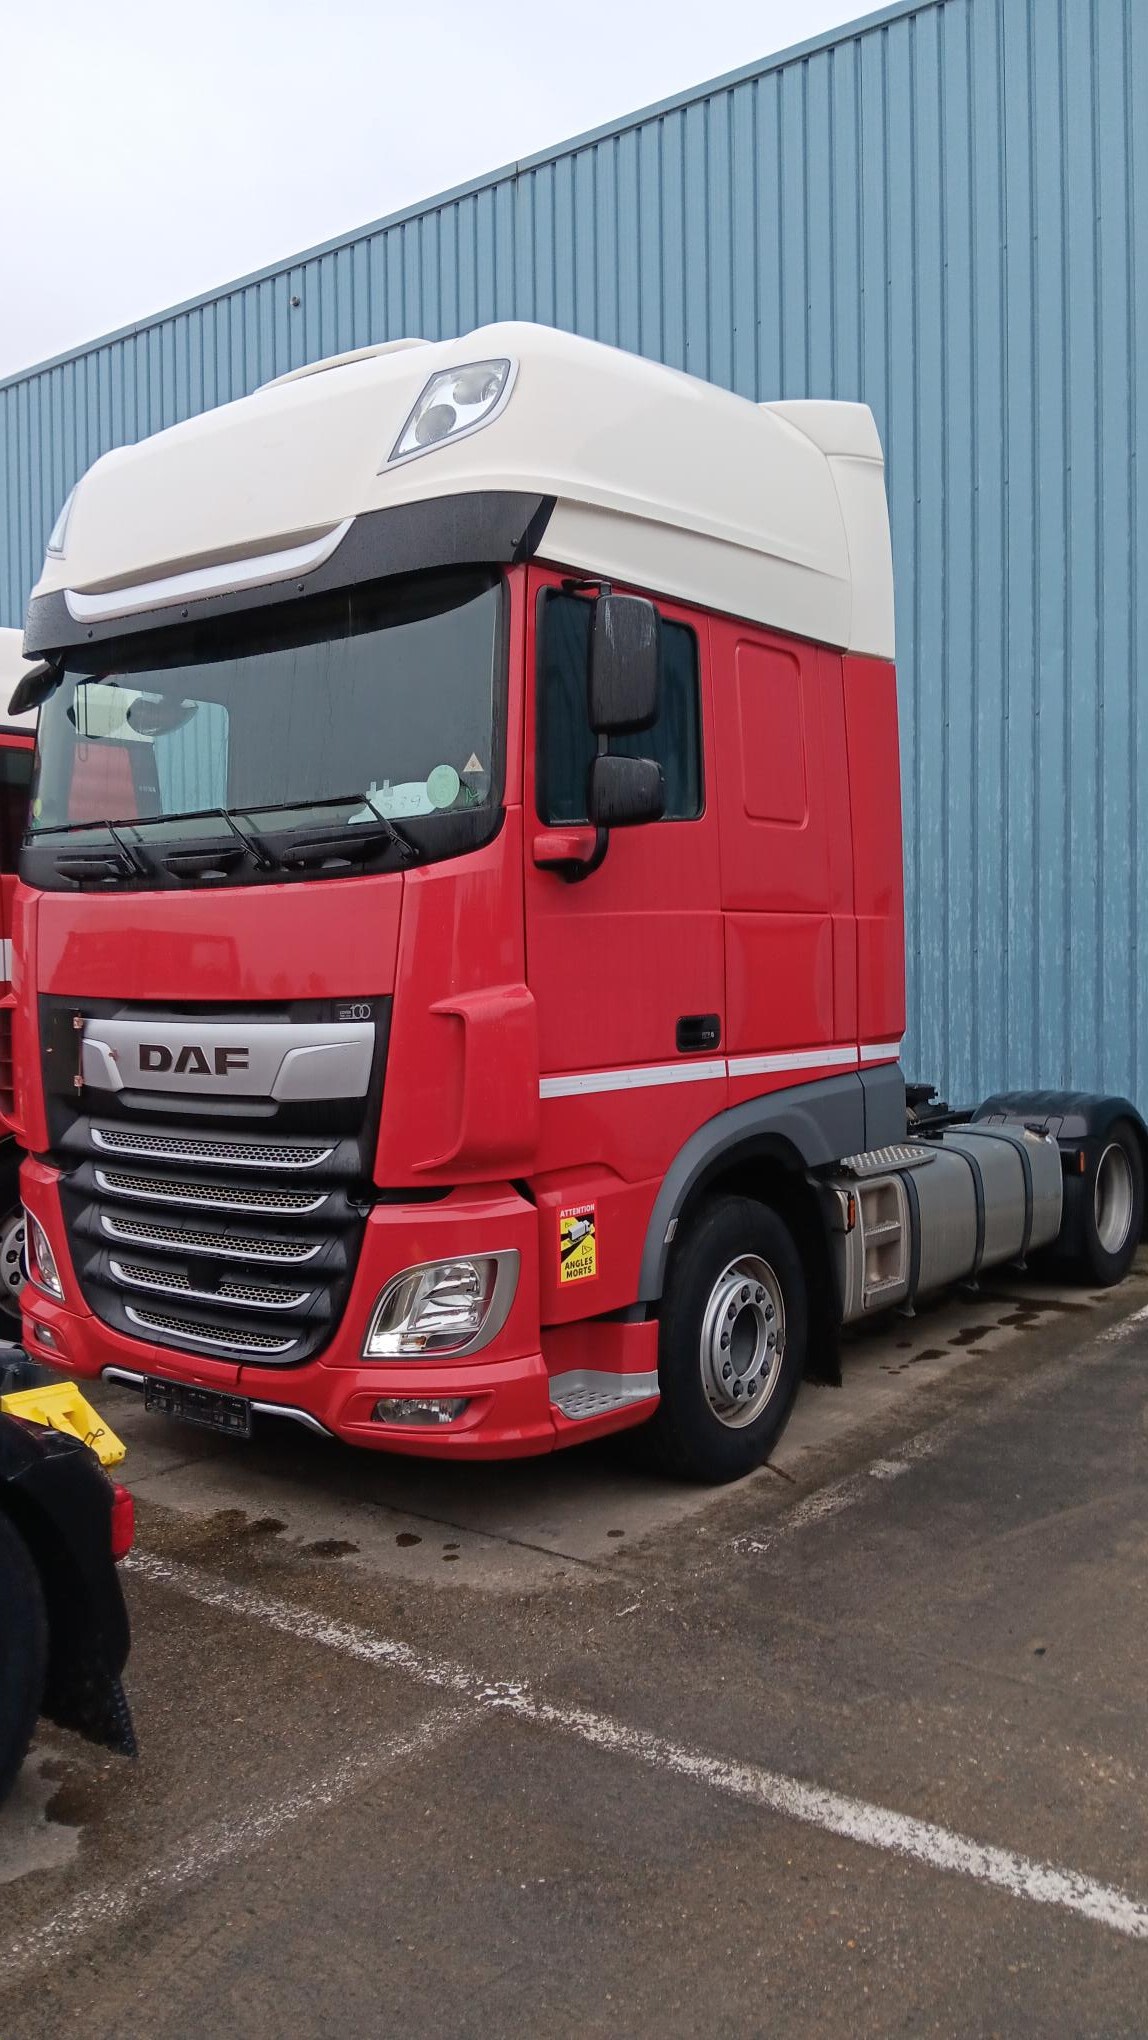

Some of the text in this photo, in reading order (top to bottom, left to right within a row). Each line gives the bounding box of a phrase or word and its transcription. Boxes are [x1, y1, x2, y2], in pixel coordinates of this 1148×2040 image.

[350, 1004, 371, 1019] 100
[139, 1043, 249, 1076] DAF
[560, 1203, 595, 1218] ATTENTION
[565, 1256, 593, 1270] ANGLES
[566, 1265, 592, 1279] MORTS
